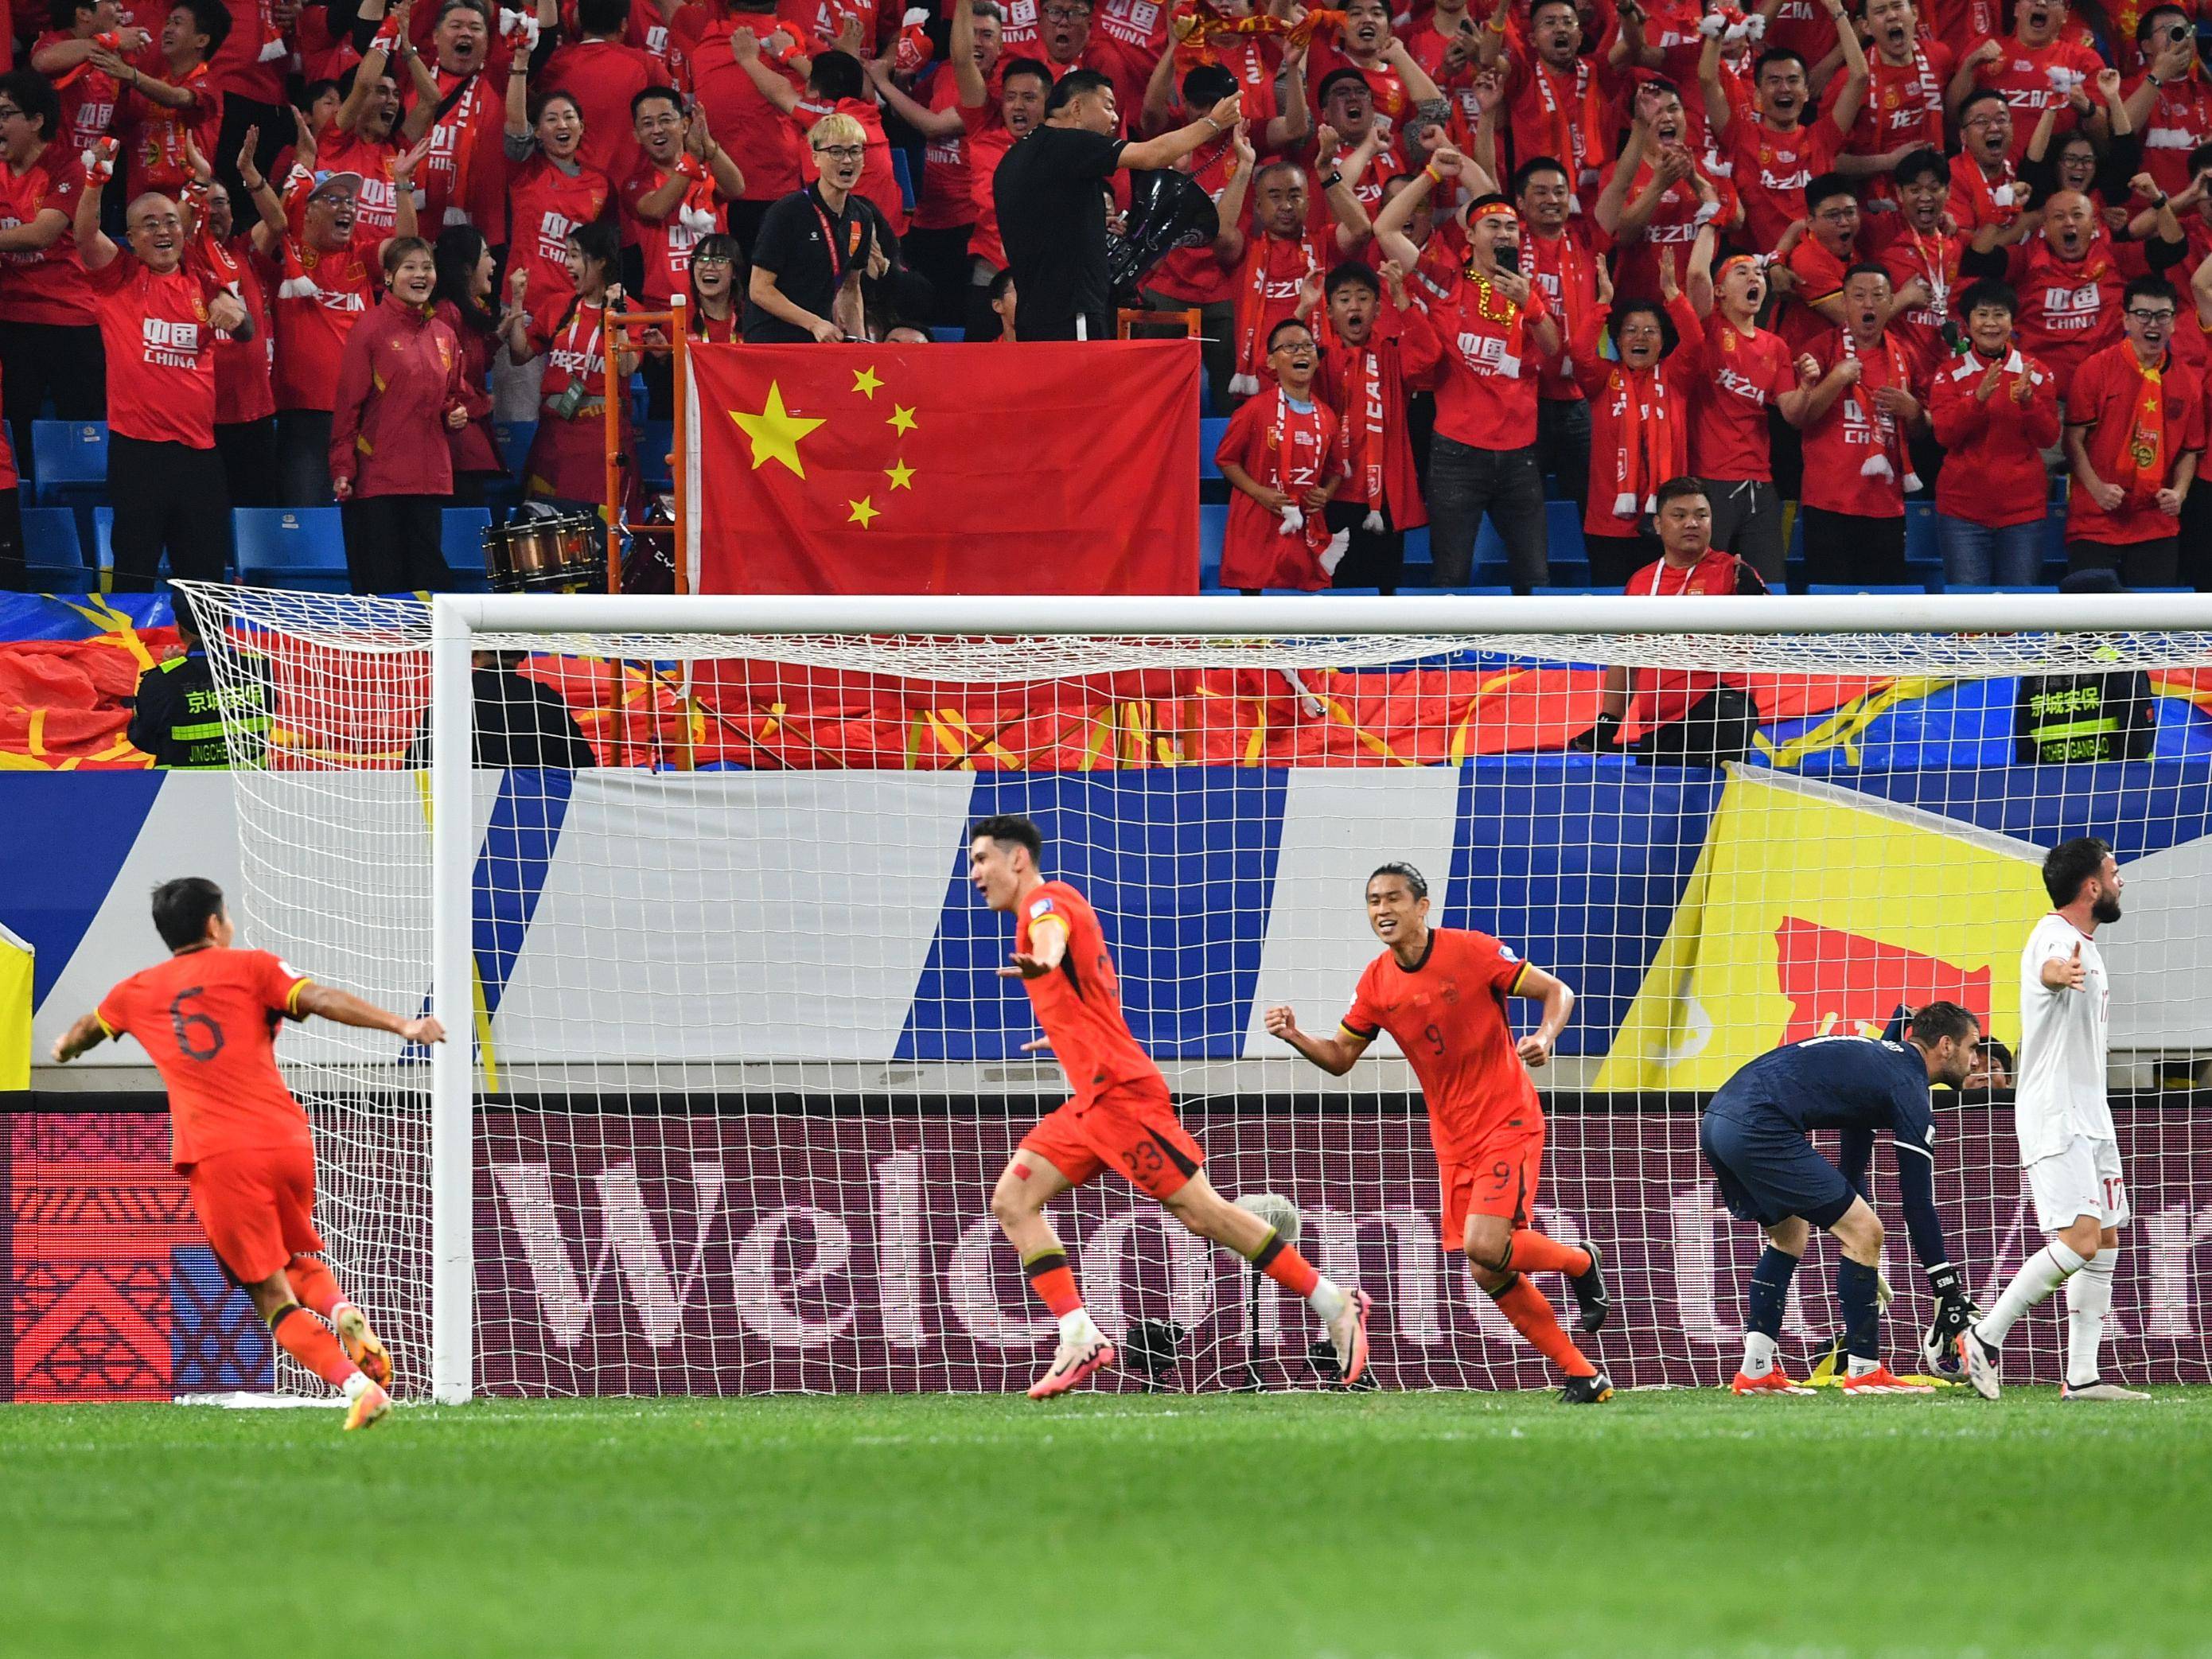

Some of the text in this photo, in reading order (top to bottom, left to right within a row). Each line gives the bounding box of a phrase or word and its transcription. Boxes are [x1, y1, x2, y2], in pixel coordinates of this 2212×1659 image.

[646, 25, 668, 53] 中
[1002, 29, 1038, 43] INA
[1102, 21, 1147, 49] CHINA
[77, 103, 114, 129] 中国
[356, 211, 396, 228] CHIN
[668, 224, 693, 251] 中
[538, 244, 567, 264] CHI
[2044, 282, 2100, 313] 中国
[143, 317, 198, 349] 中国
[2046, 315, 2098, 330] CHINA
[144, 349, 197, 370] CHINA
[1457, 332, 1507, 360] 中国
[2029, 687, 2100, 717] 京城安保
[171, 986, 224, 1063] 6
[1425, 1023, 1447, 1056] 9
[1120, 1141, 1164, 1180] 23
[1492, 1161, 1512, 1190] 9
[2103, 1177, 2124, 1211] 17
